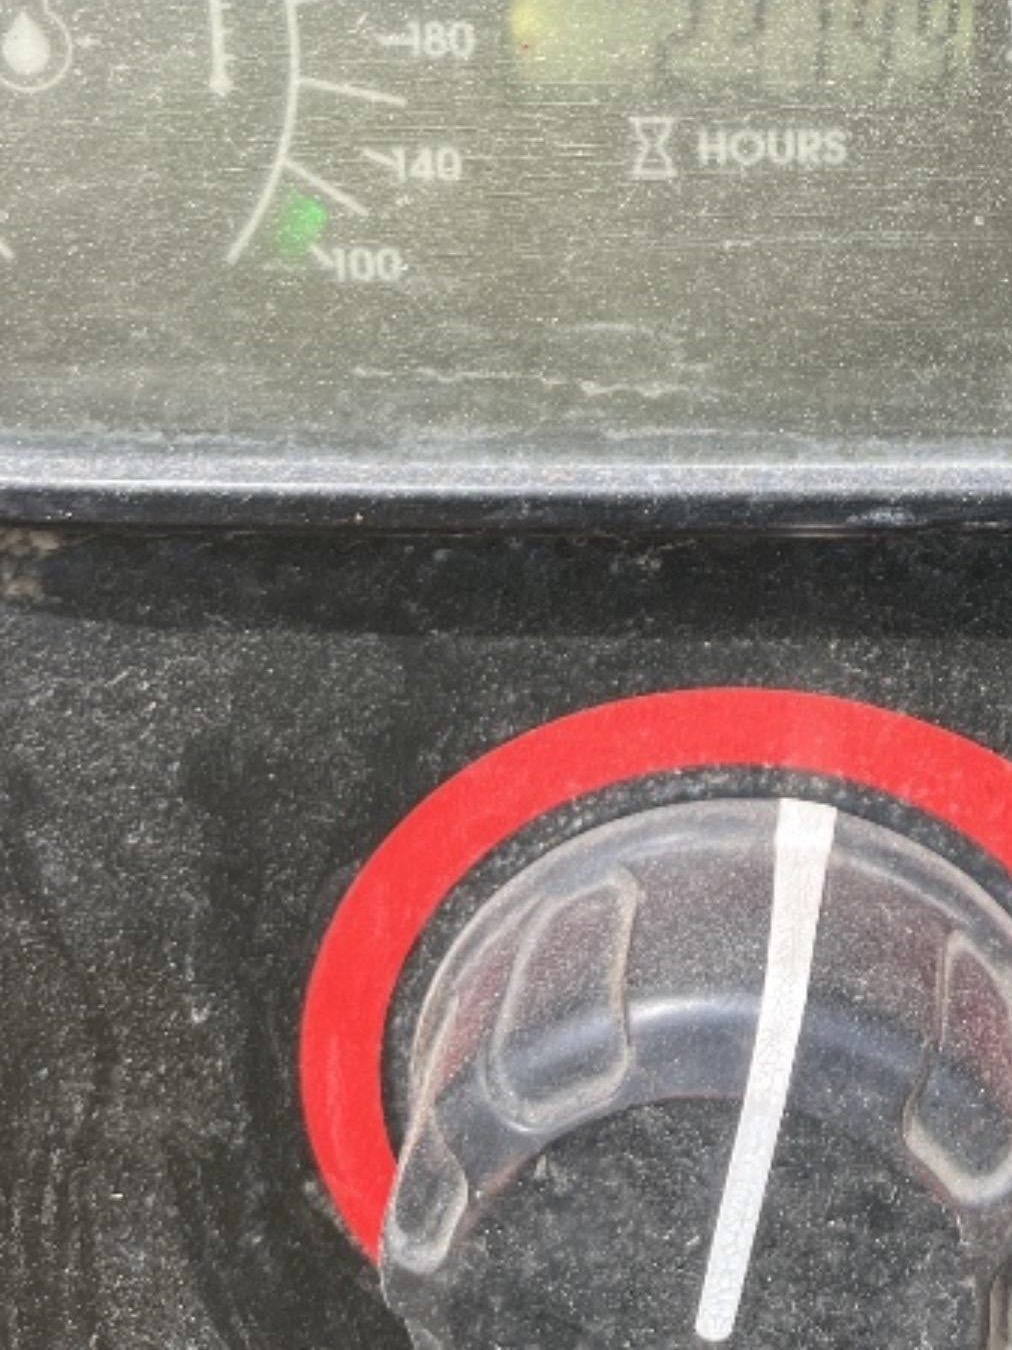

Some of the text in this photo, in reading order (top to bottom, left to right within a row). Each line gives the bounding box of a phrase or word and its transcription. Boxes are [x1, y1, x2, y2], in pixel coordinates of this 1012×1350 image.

[407, 23, 475, 57] 180
[698, 130, 849, 166] HOURS
[396, 149, 462, 181] 140
[333, 248, 402, 281] 100
